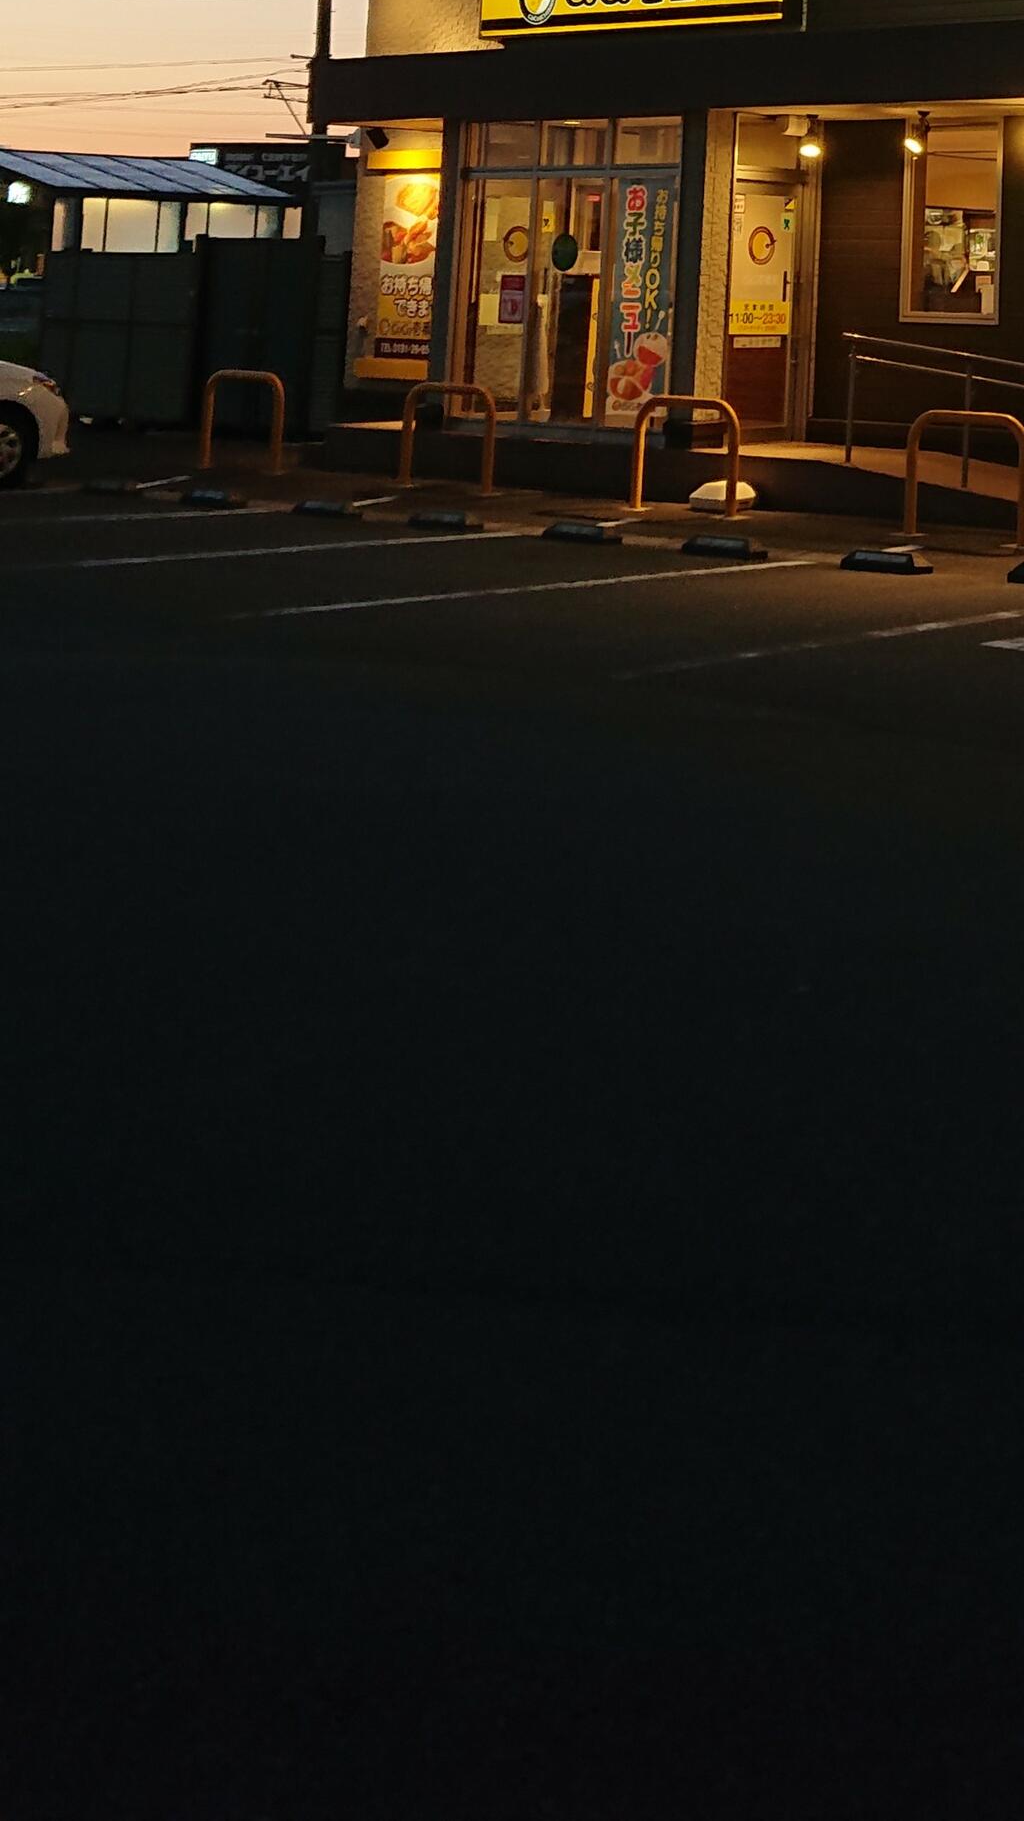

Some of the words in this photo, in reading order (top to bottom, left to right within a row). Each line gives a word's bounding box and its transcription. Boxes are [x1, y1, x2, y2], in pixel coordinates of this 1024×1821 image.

[621, 185, 648, 358] お子様メニュー
